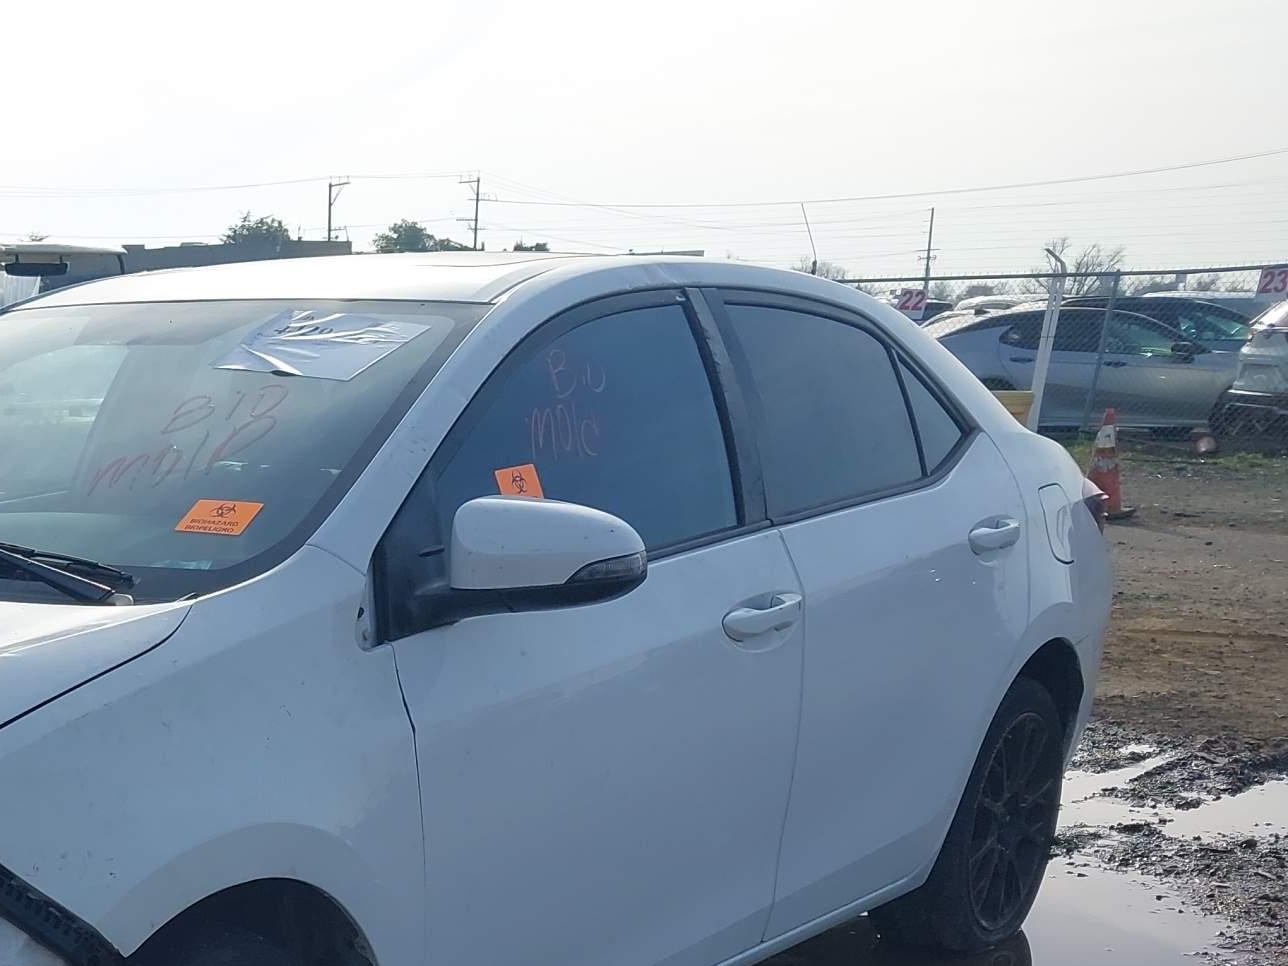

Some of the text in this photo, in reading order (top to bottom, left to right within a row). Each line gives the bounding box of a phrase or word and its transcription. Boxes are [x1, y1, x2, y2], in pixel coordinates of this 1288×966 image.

[1260, 270, 1288, 293] 23
[898, 290, 926, 311] 22
[184, 524, 235, 533] BIOPELIGRO
[189, 518, 240, 527] BIOHAZARD
